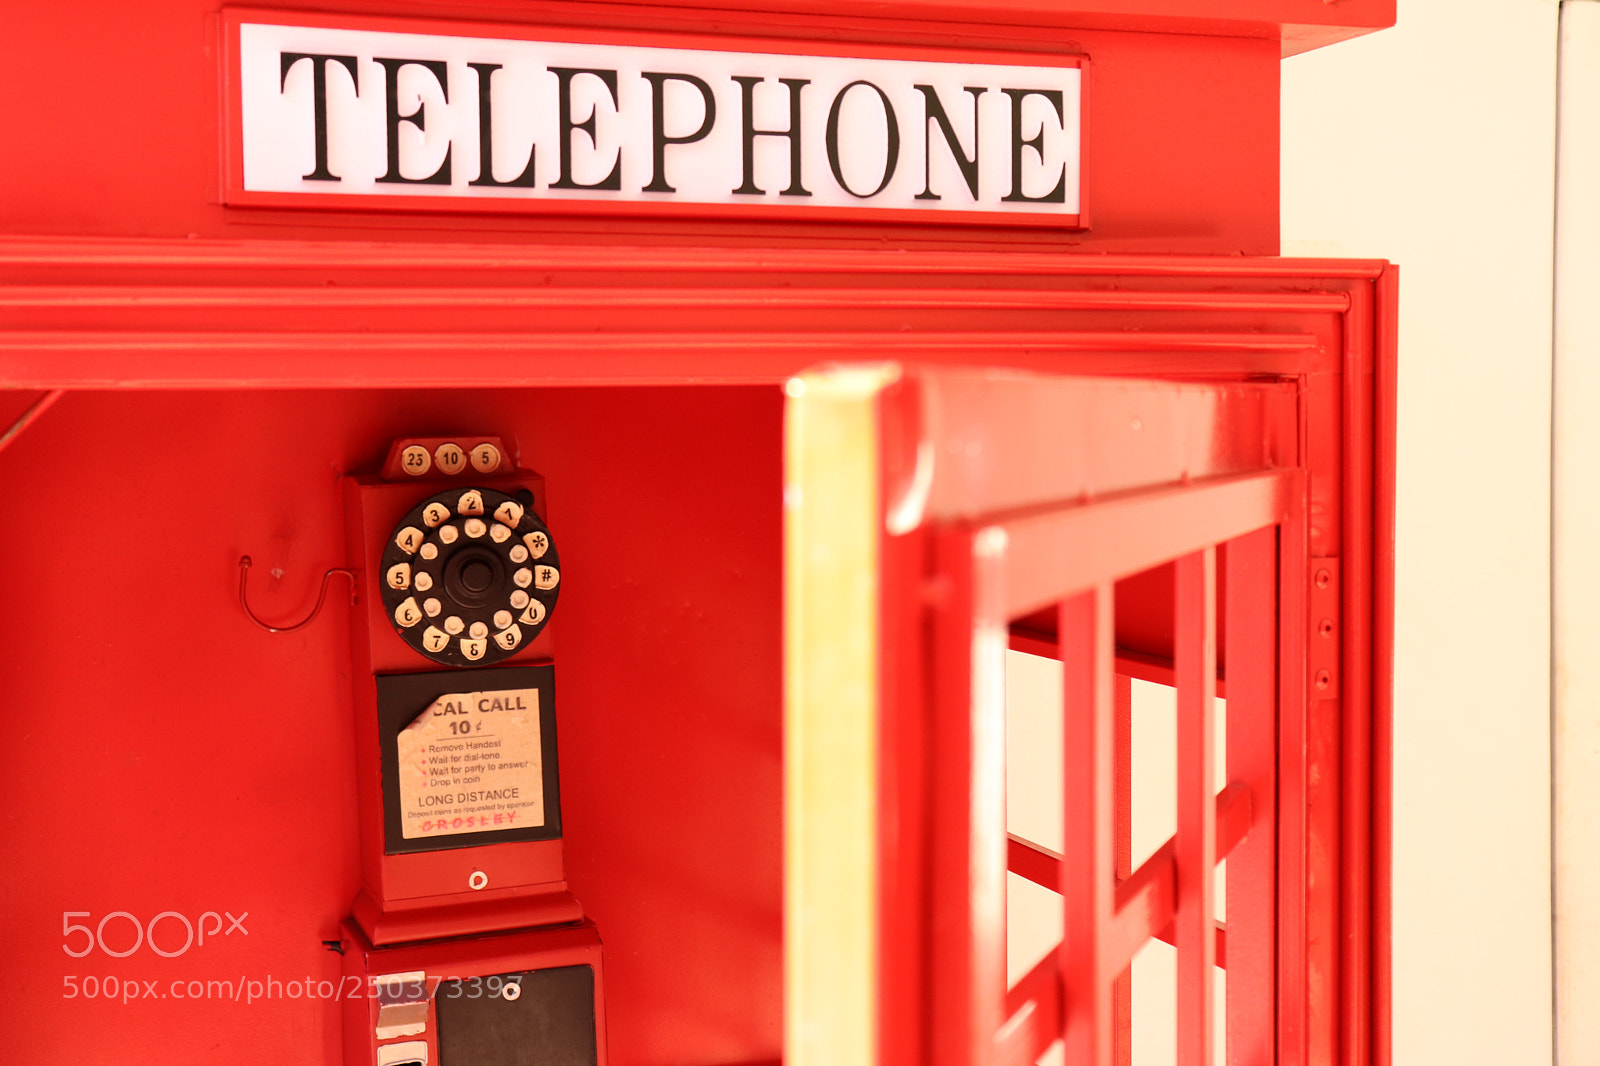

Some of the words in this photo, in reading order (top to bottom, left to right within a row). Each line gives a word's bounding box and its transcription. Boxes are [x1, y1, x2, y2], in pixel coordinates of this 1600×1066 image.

[280, 51, 1066, 204] TELEPHONE
[407, 453, 423, 466] 25
[443, 452, 458, 465] 10
[482, 452, 489, 464] 5
[467, 496, 476, 510] 2
[430, 510, 440, 522] 3
[504, 508, 513, 521] 1
[404, 534, 413, 546] 4
[395, 572, 404, 584] 5
[541, 569, 552, 582] #
[404, 608, 413, 621] 6
[433, 635, 441, 648] 7
[506, 633, 515, 645] 9
[470, 643, 478, 656] 8
[478, 696, 527, 713] CALL
[450, 720, 471, 735] 10
[428, 744, 464, 754] Remove
[429, 756, 449, 765] Wait
[450, 754, 462, 763] for
[429, 767, 450, 776] Wait
[451, 765, 462, 774] for
[464, 763, 485, 775] party
[487, 762, 496, 771] to
[498, 760, 528, 769] answer
[430, 778, 451, 788] Drop
[453, 776, 461, 785] in
[462, 775, 480, 784] coin
[418, 794, 454, 808] LONG
[457, 787, 520, 804] DISTANCE
[497, 801, 505, 811] by
[421, 810, 517, 832] CROSLEY
